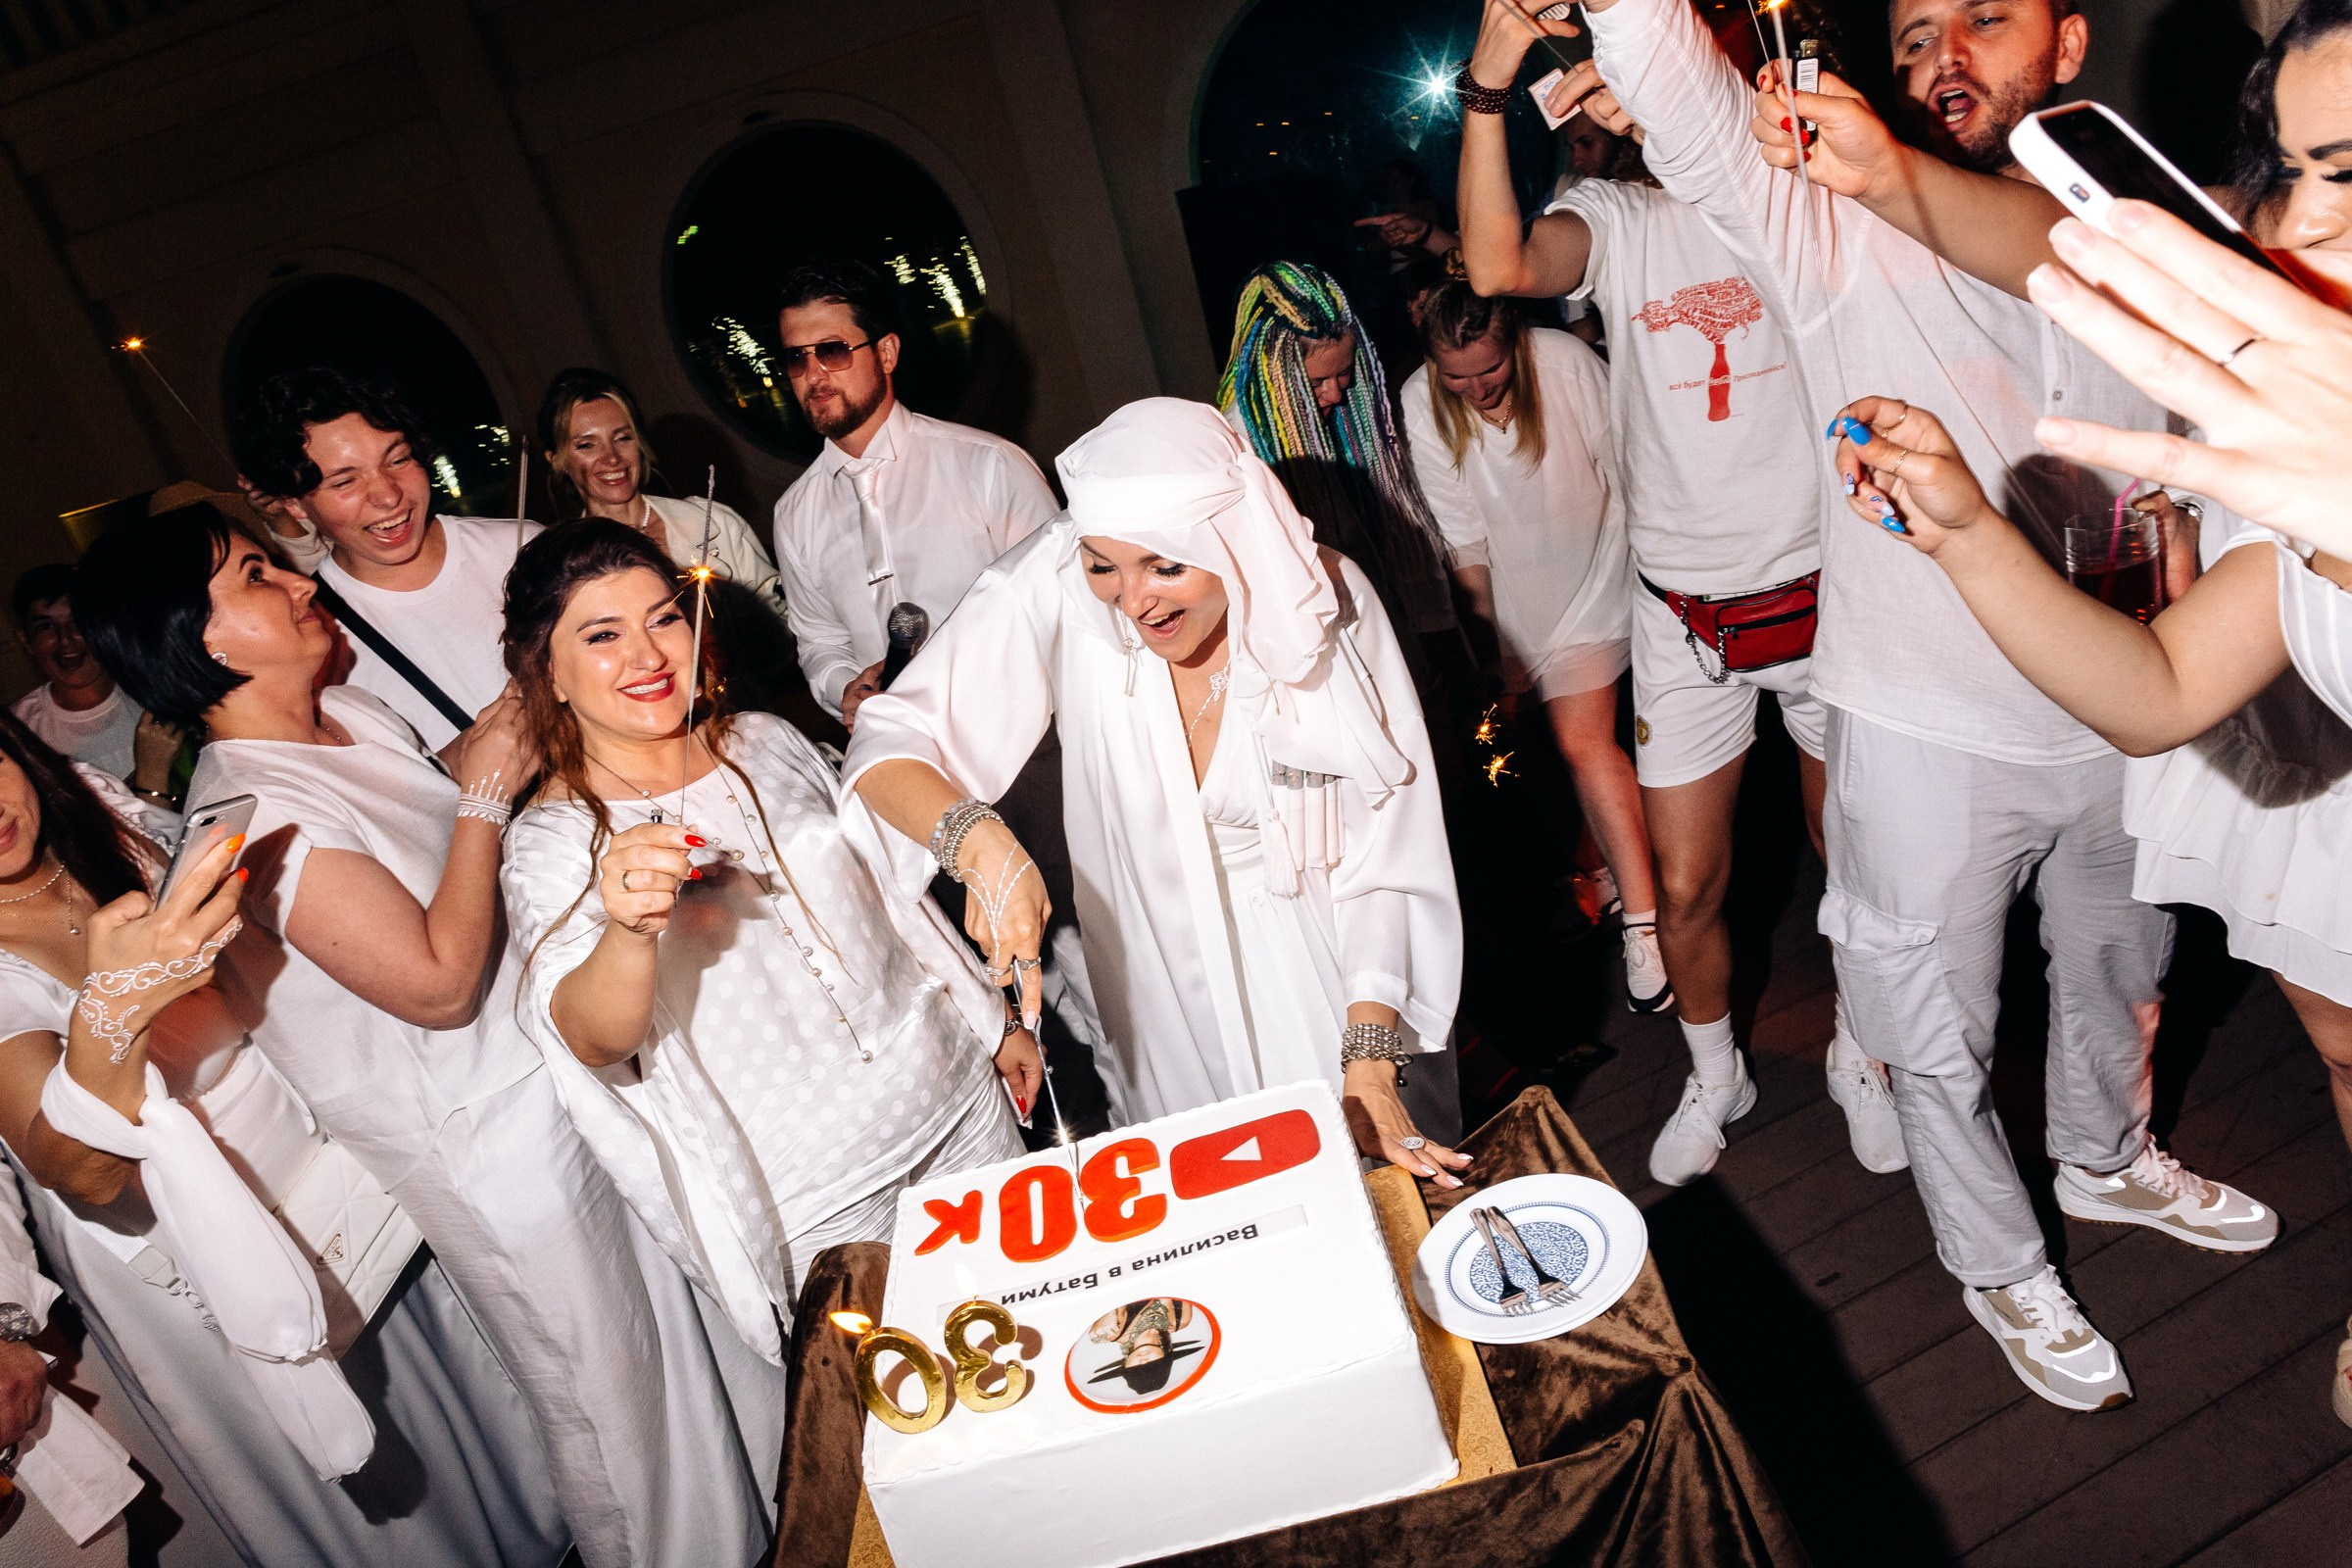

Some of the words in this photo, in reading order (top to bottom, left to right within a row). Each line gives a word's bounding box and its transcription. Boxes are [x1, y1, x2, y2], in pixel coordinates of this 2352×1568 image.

[1684, 379, 1706, 390] будет
[1132, 1223, 1259, 1272] Василина
[1108, 1264, 1122, 1278] в
[1001, 1274, 1099, 1306] Батуми
[855, 1298, 1027, 1435] 30
